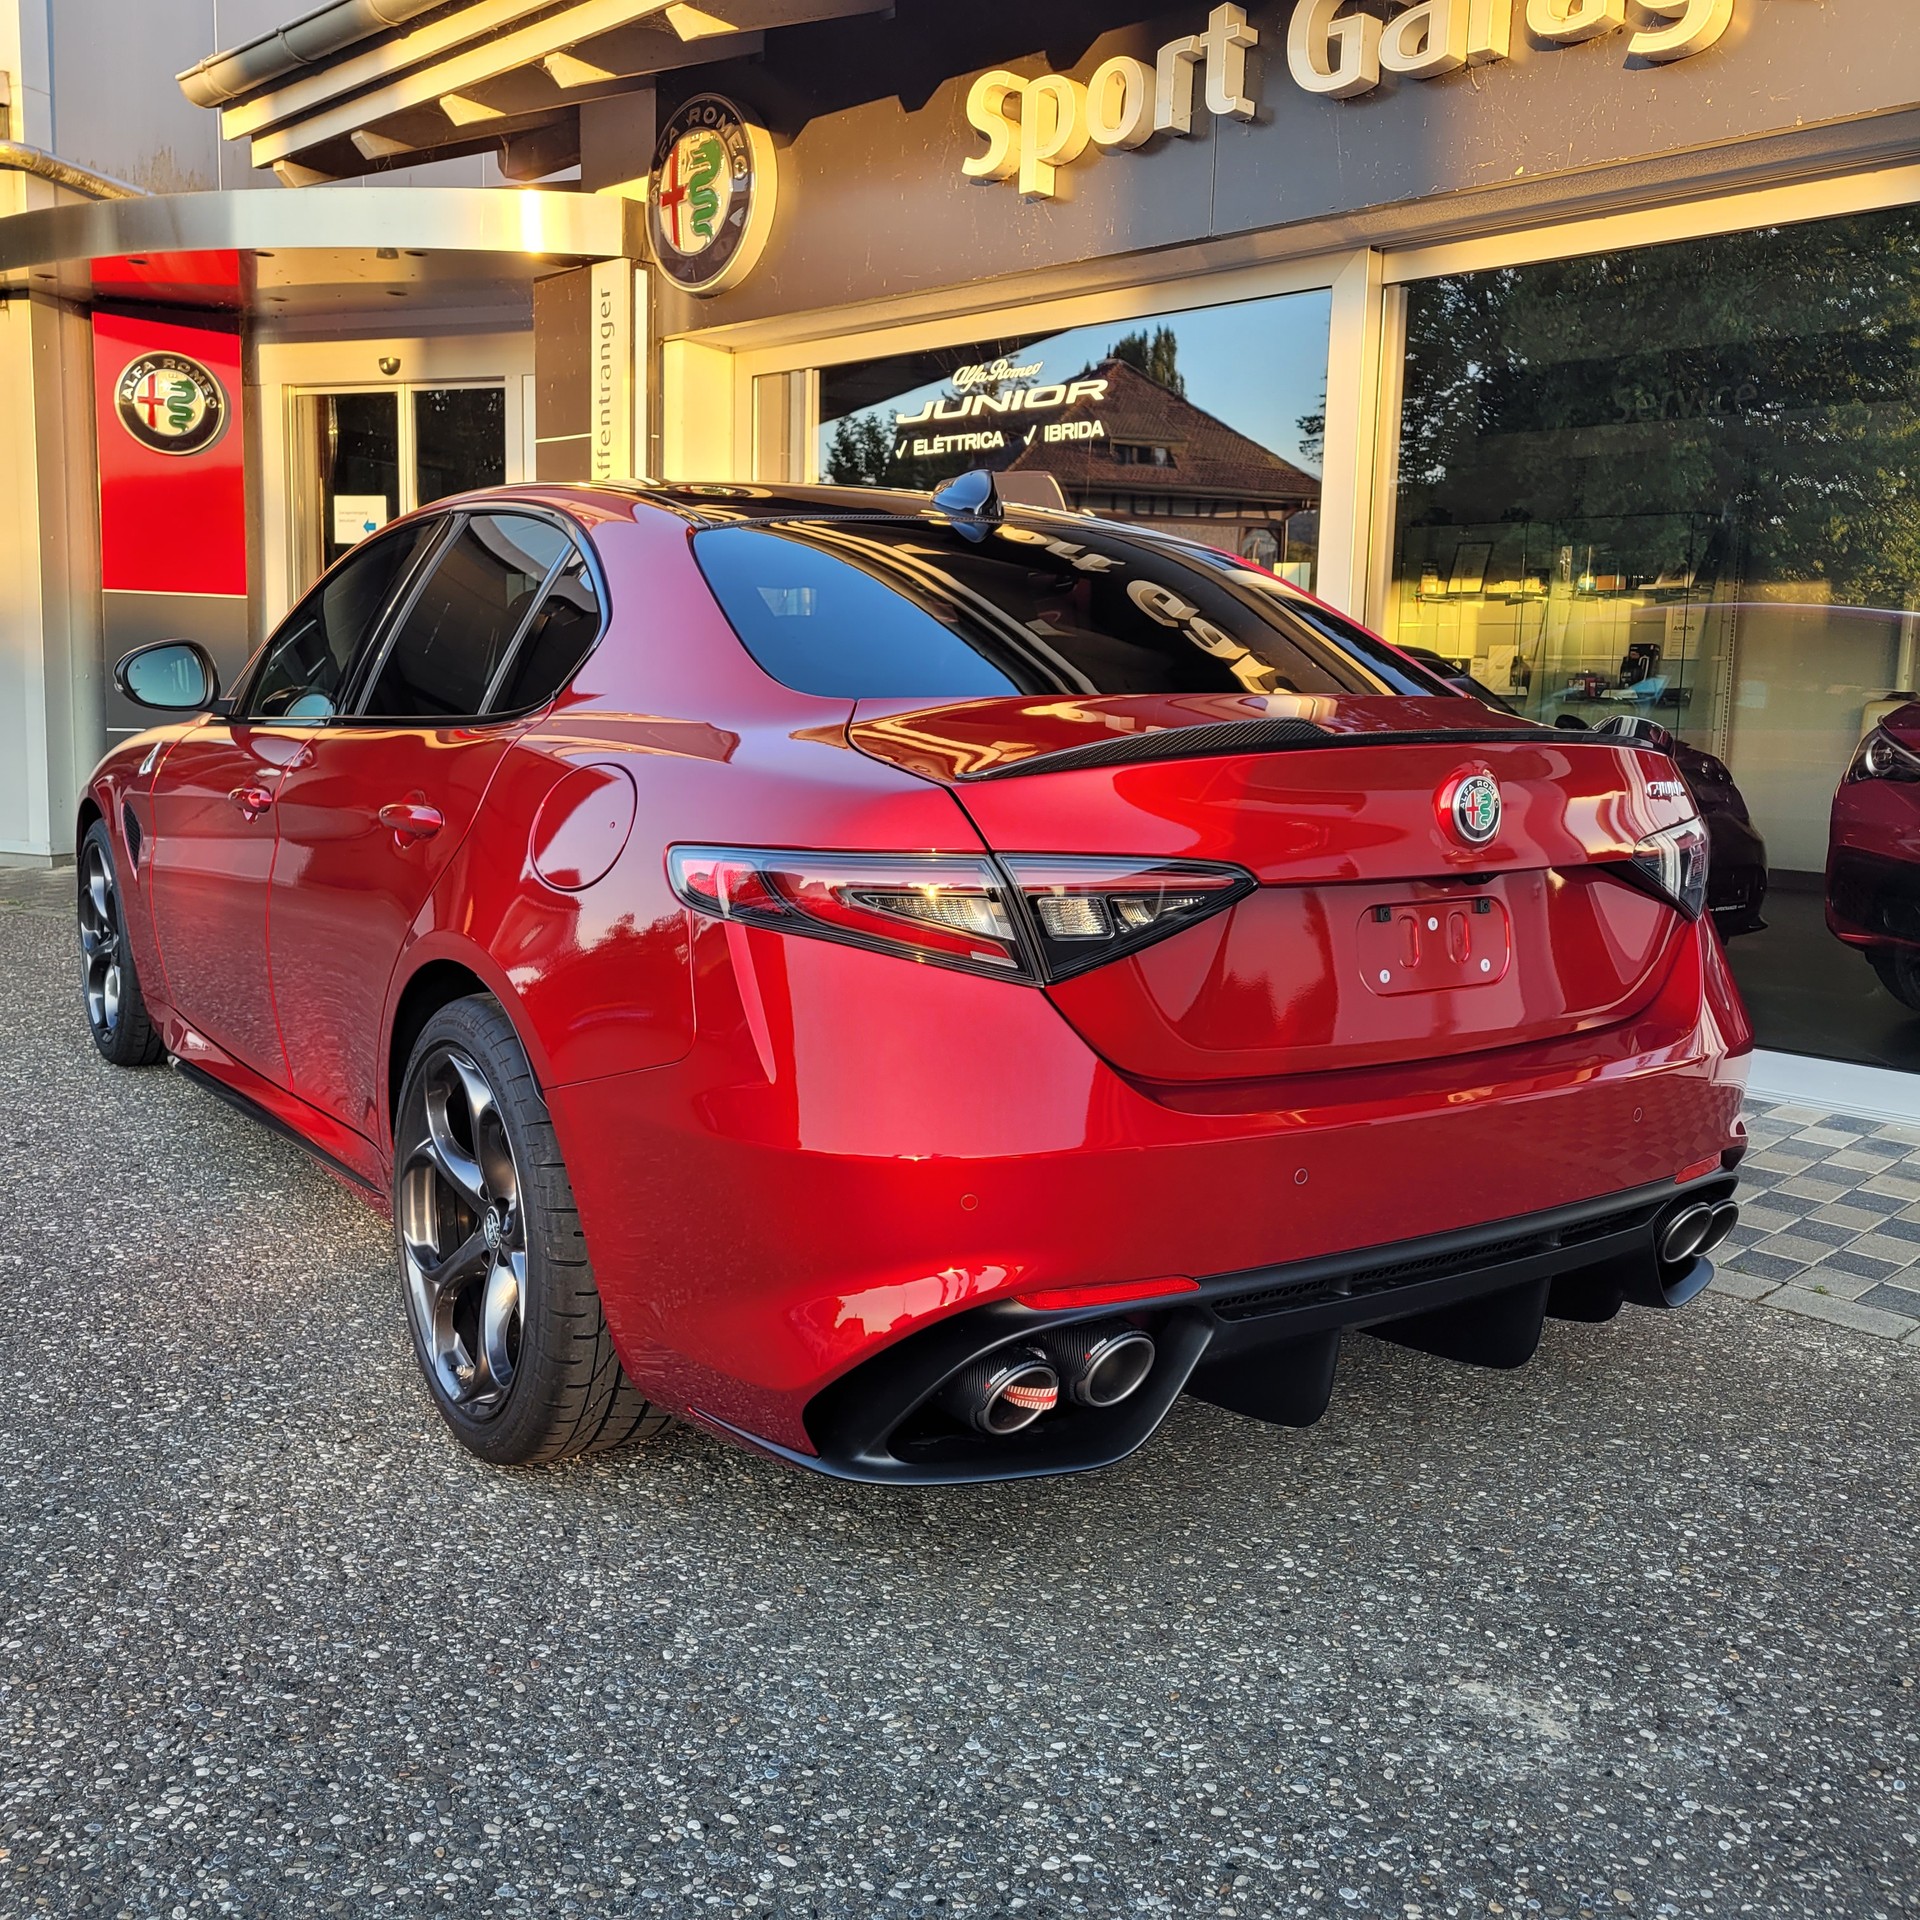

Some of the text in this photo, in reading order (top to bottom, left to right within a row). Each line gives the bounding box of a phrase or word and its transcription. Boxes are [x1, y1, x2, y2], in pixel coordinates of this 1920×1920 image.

[961, 2, 1258, 197] Sport
[686, 105, 748, 181] ROMEO
[122, 358, 217, 409] ALFA ROMEO
[597, 288, 615, 479] ffentranger
[952, 358, 1044, 392] Alfa Romeo
[896, 379, 1109, 424] JUNIOR
[1612, 382, 1759, 424] Service
[1044, 420, 1105, 443] IBRIDA
[1460, 780, 1499, 810] ALFA ROMO
